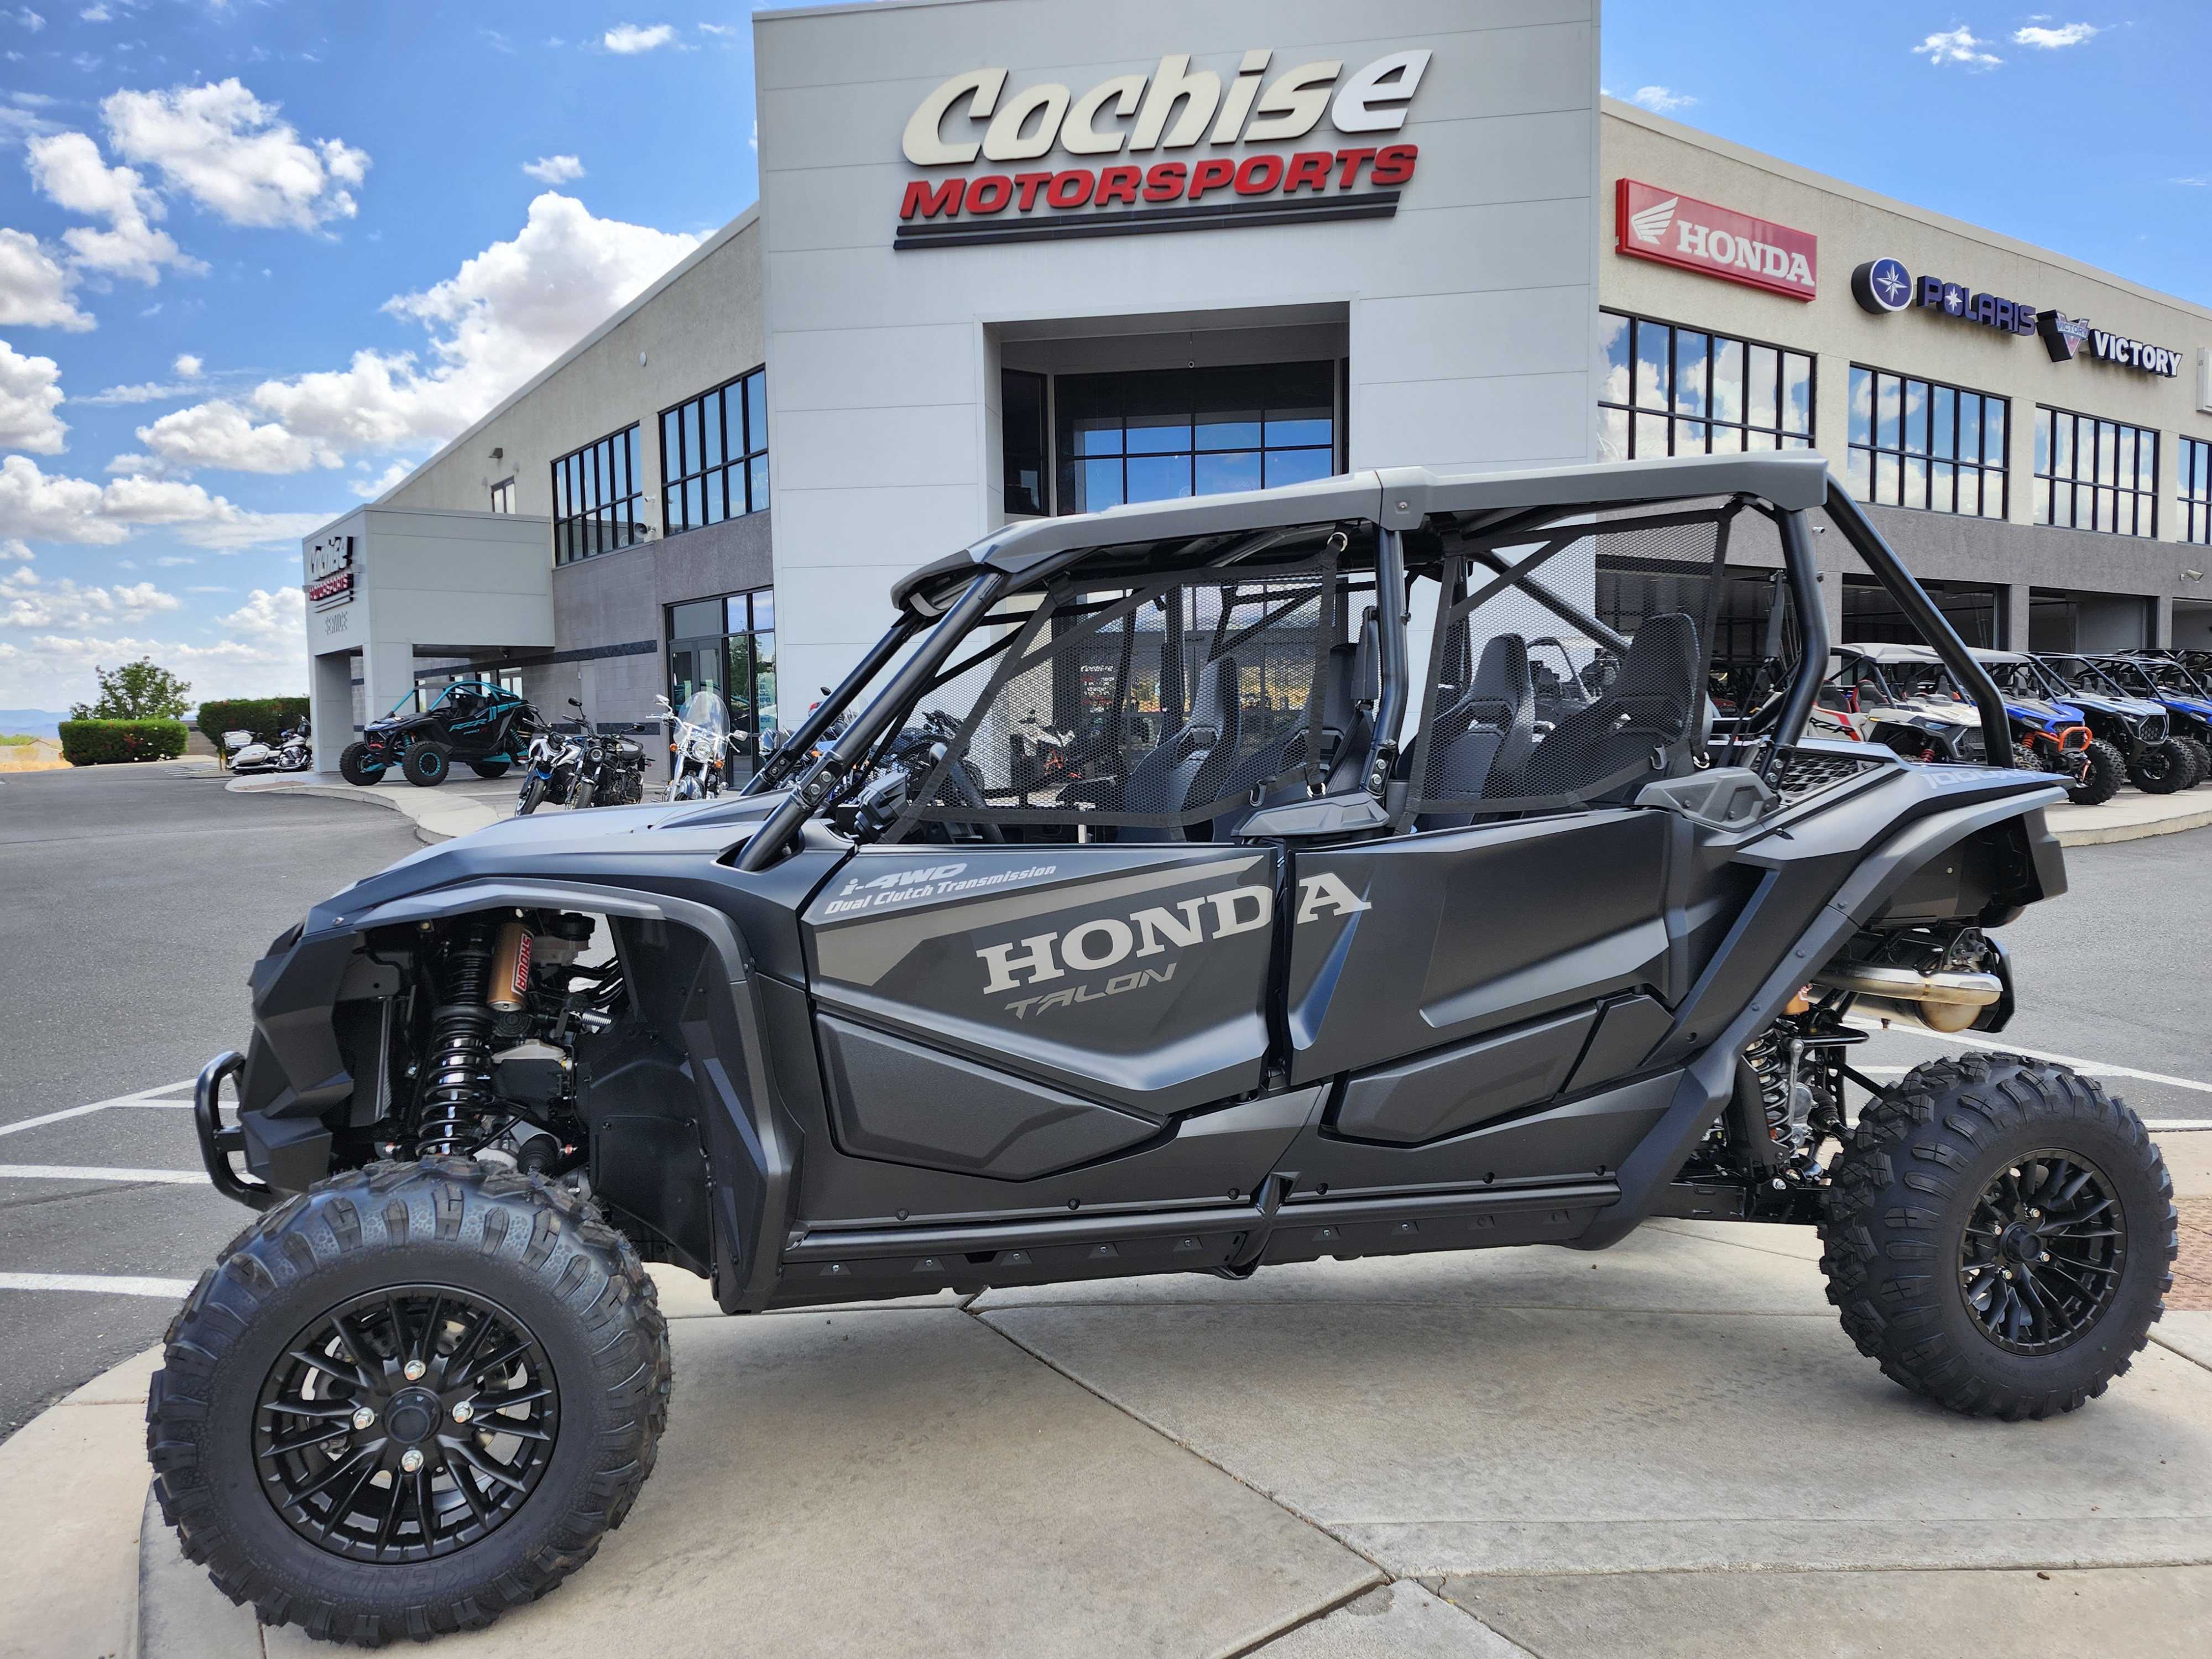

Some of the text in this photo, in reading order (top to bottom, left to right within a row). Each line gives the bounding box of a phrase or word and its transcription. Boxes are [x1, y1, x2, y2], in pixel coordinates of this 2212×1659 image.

[902, 48, 1433, 166] Cochise
[899, 144, 1419, 220] MOTORSPORTS
[1677, 220, 1815, 286] HONDA
[1918, 275, 2036, 336] POLARIS
[2057, 321, 2088, 337] VICTORY
[2091, 329, 2183, 377] VICTORY
[325, 611, 348, 635] SERVICE
[448, 718, 487, 733] RZR
[825, 865, 1057, 915] Dual Clutch Transmission
[839, 863, 968, 896] i-4WD
[976, 872, 1371, 994] HONDA
[515, 932, 532, 991] SHOWA
[1004, 962, 1177, 1020] TALON
[307, 1553, 478, 1597] KENDA
